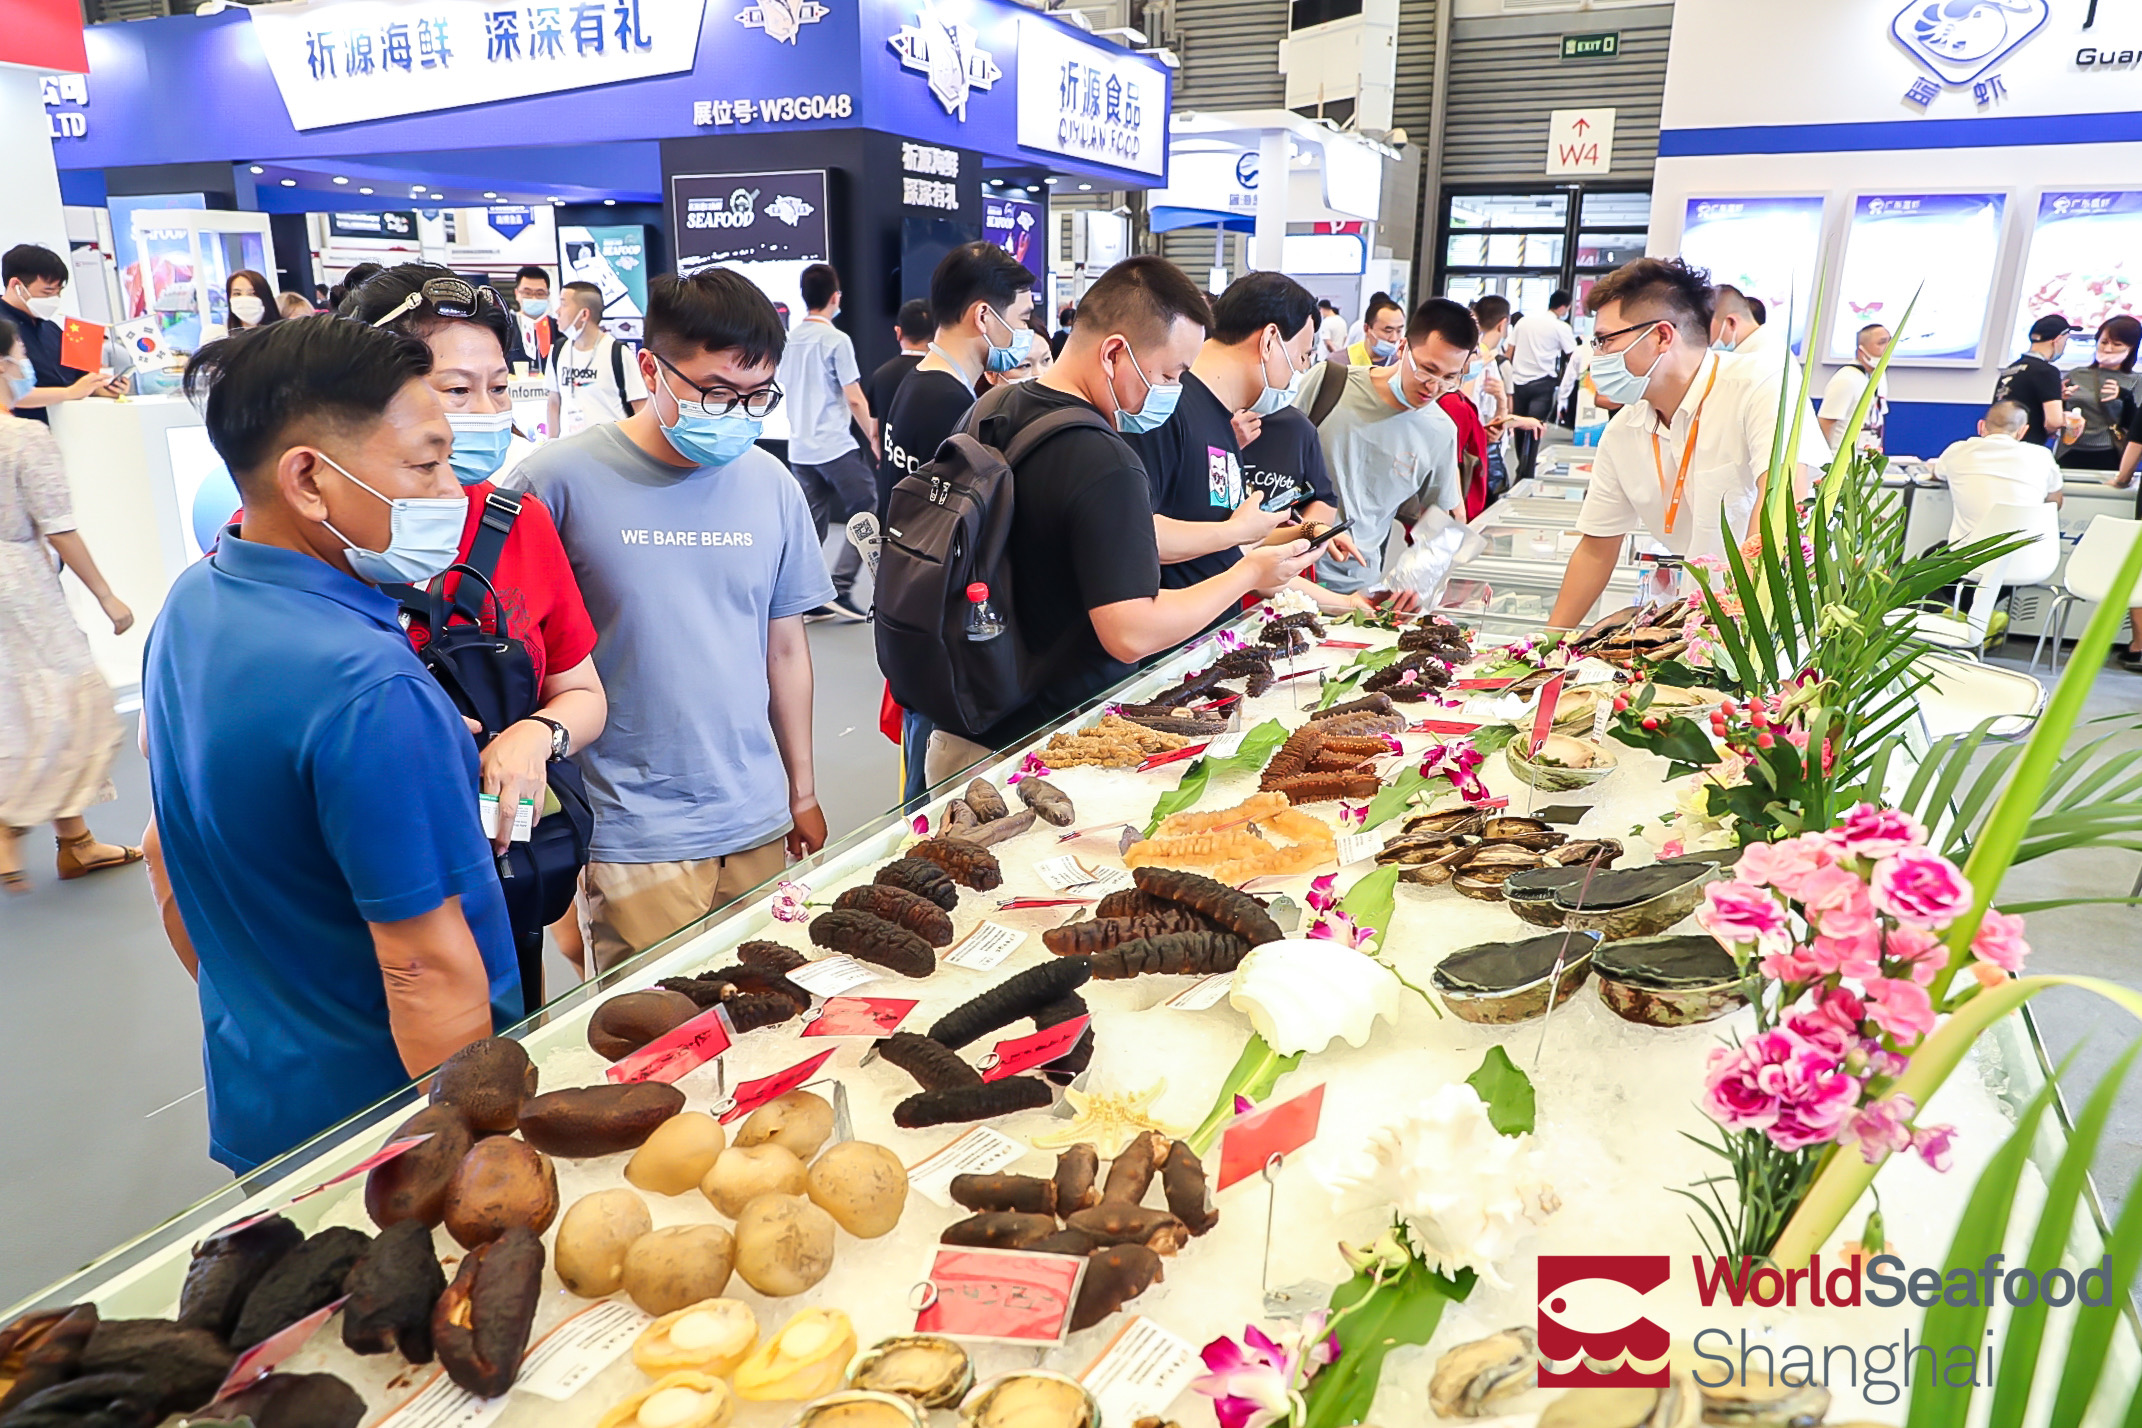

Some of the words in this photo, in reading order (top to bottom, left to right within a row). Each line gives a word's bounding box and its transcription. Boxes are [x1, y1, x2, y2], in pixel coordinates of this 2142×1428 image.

[484, 0, 653, 61] 深深有礼
[1577, 40, 1601, 53] EXIT
[1059, 58, 1141, 129] 祈源食品
[46, 112, 86, 137] LTD
[1559, 143, 1599, 166] W4
[687, 211, 755, 229] SEAFOOD
[621, 529, 650, 544] WE
[653, 530, 697, 546] BARE
[701, 530, 754, 547] BEARS
